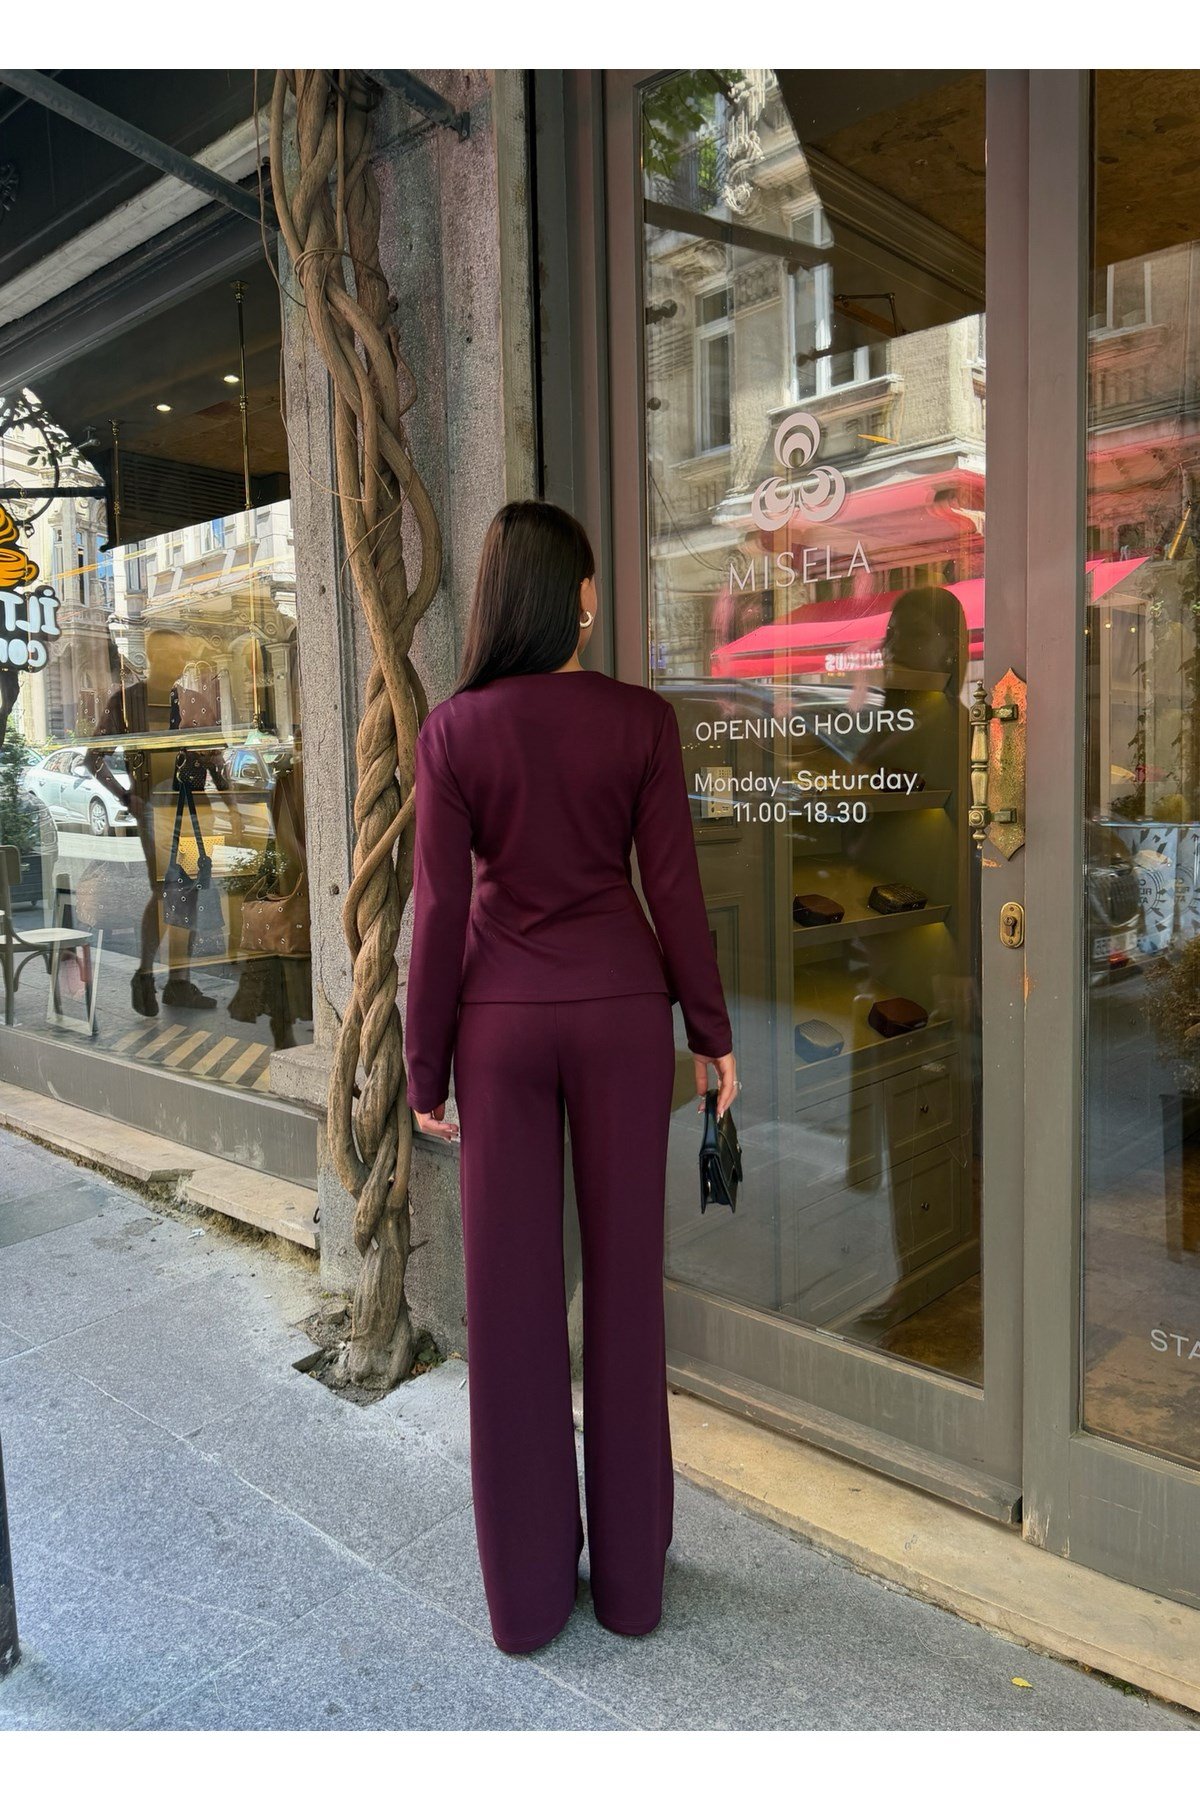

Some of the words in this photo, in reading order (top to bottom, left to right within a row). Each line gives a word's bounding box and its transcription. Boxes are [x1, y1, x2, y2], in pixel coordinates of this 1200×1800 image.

[729, 540, 871, 595] MISELA
[695, 715, 806, 742] OPENING
[814, 708, 915, 736] HOURS
